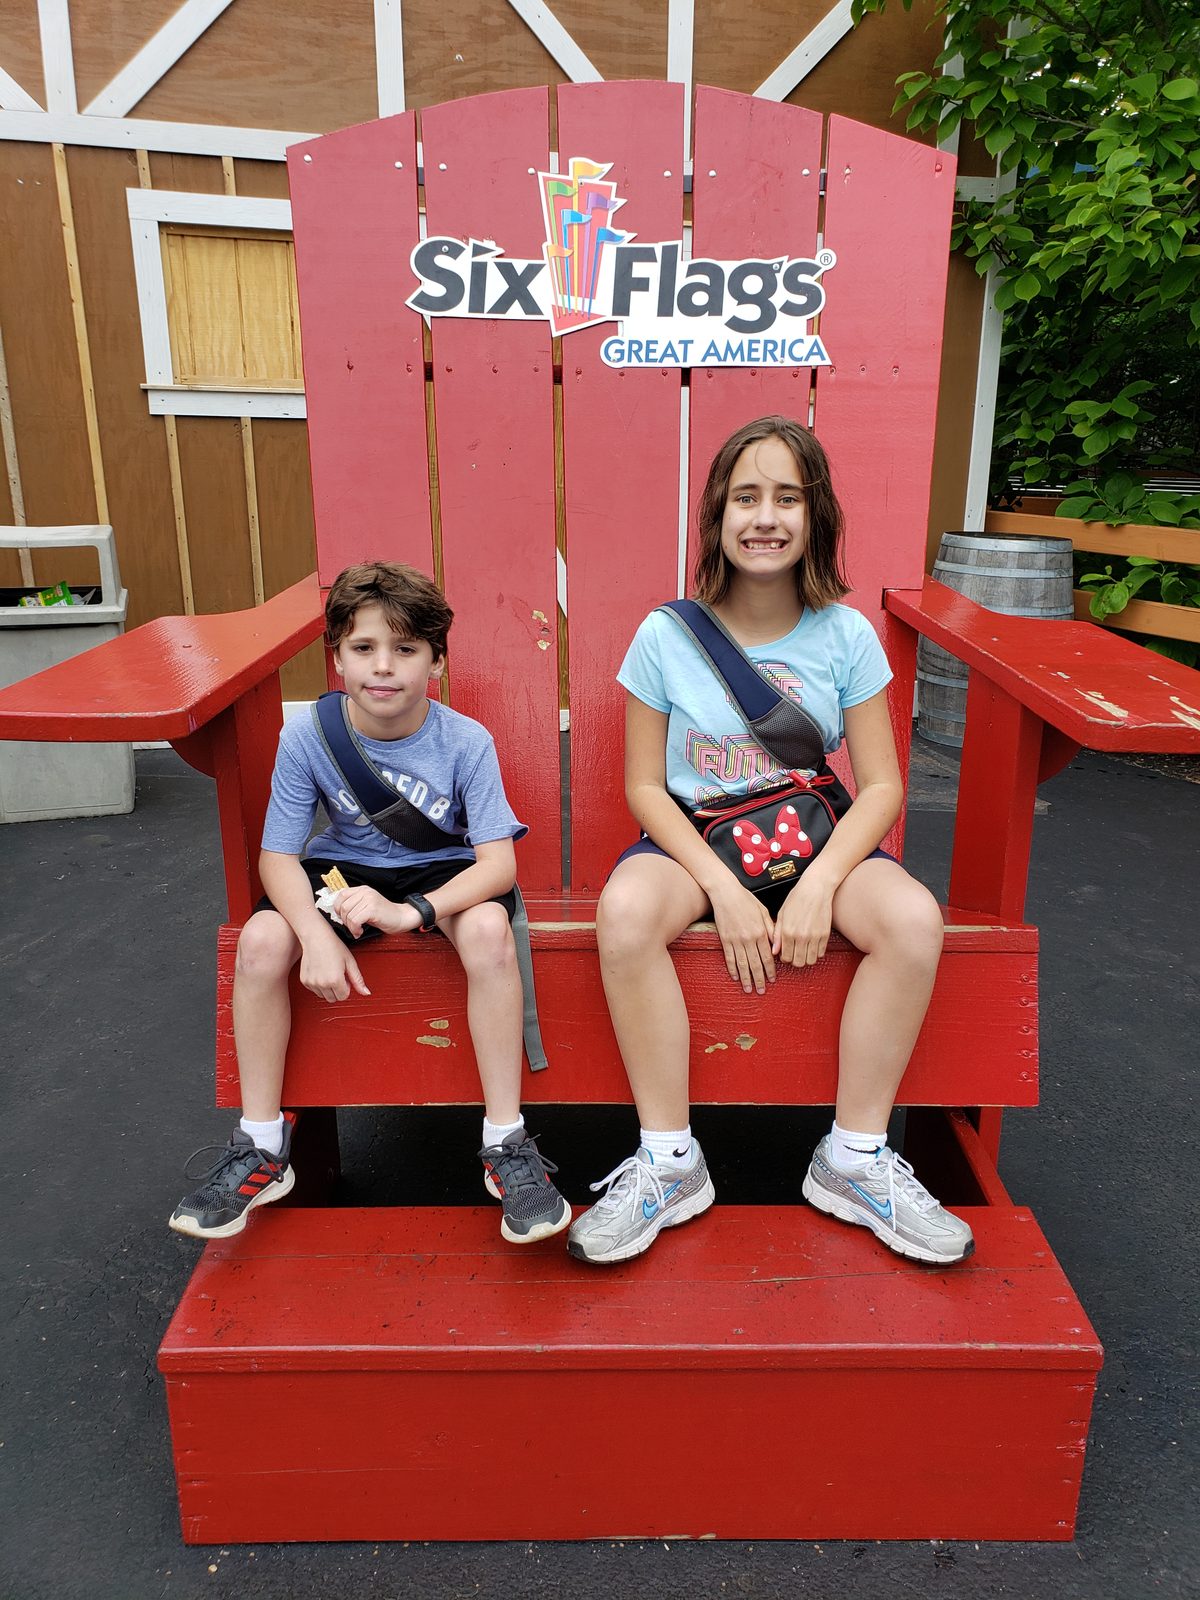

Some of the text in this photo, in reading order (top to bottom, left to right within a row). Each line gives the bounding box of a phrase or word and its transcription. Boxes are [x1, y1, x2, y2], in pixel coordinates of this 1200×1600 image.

[411, 239, 546, 316] Six
[611, 244, 824, 334] Flags
[603, 338, 827, 364] GREAT AMERICA
